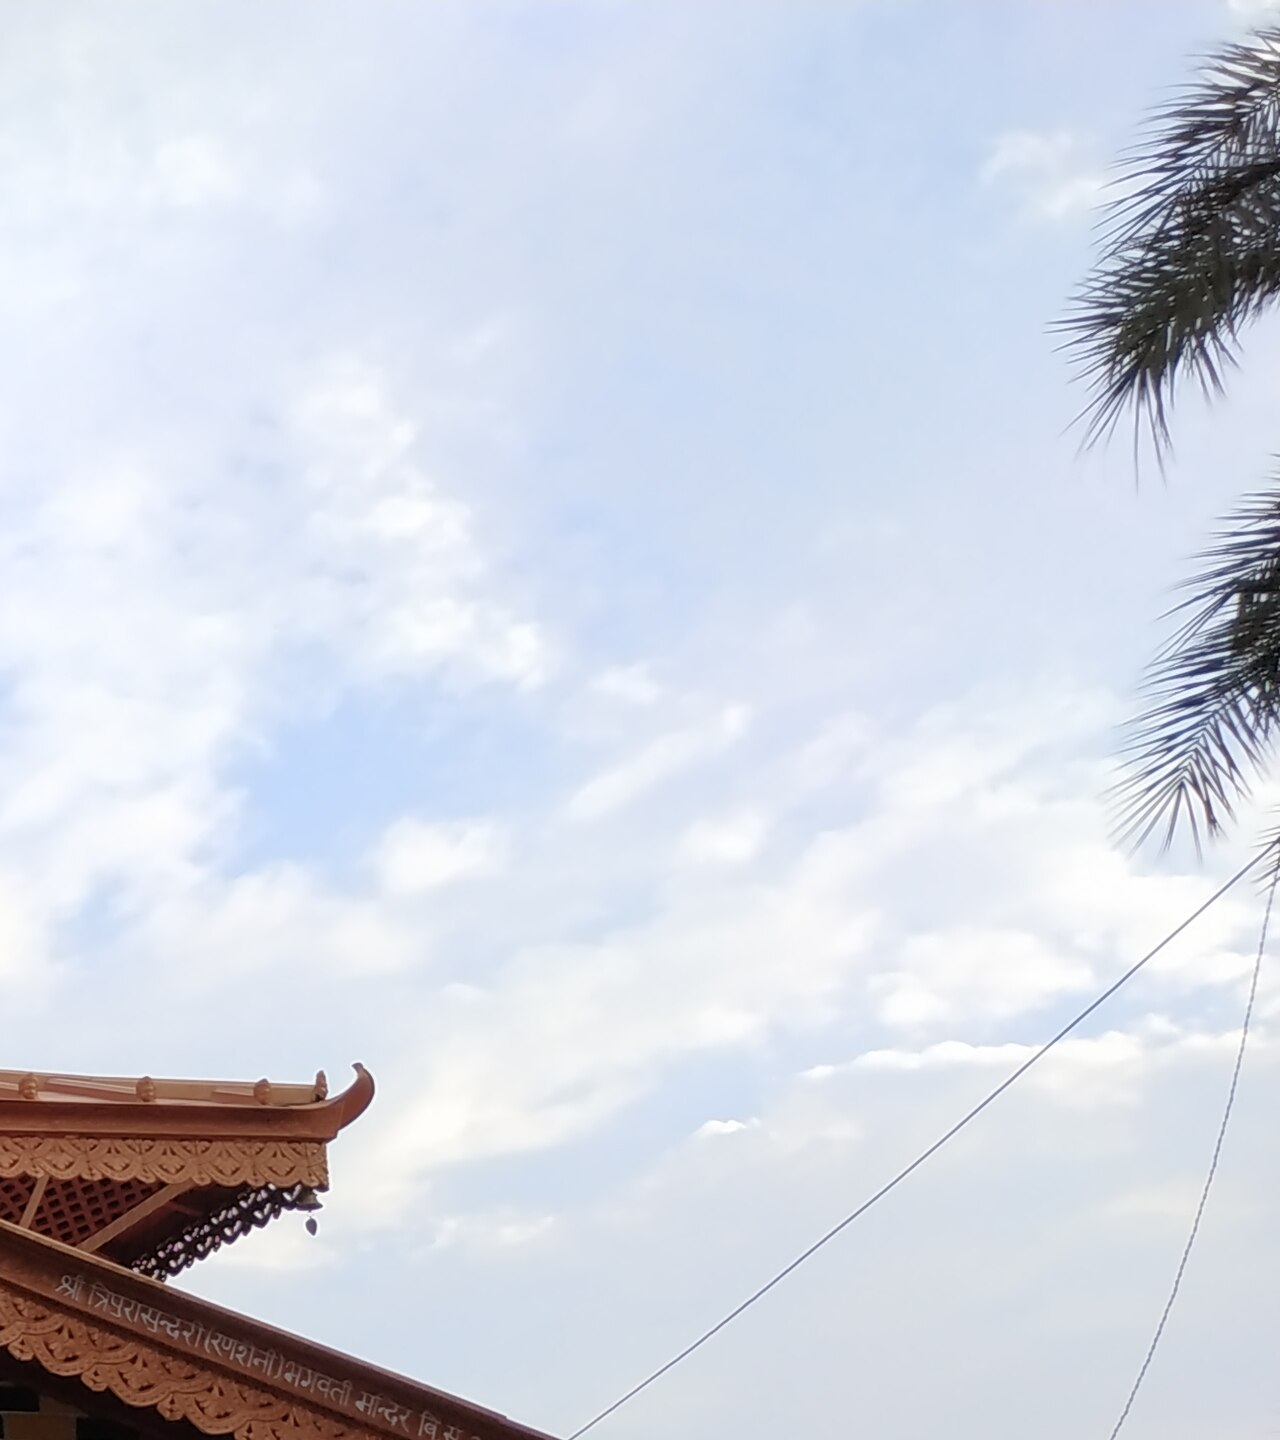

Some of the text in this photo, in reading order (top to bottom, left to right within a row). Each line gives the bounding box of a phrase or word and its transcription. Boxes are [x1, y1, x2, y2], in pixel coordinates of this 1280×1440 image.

[54, 1274, 86, 1302] श्री
[283, 1360, 353, 1406] भगवती
[355, 1390, 414, 1433] मन्दिर
